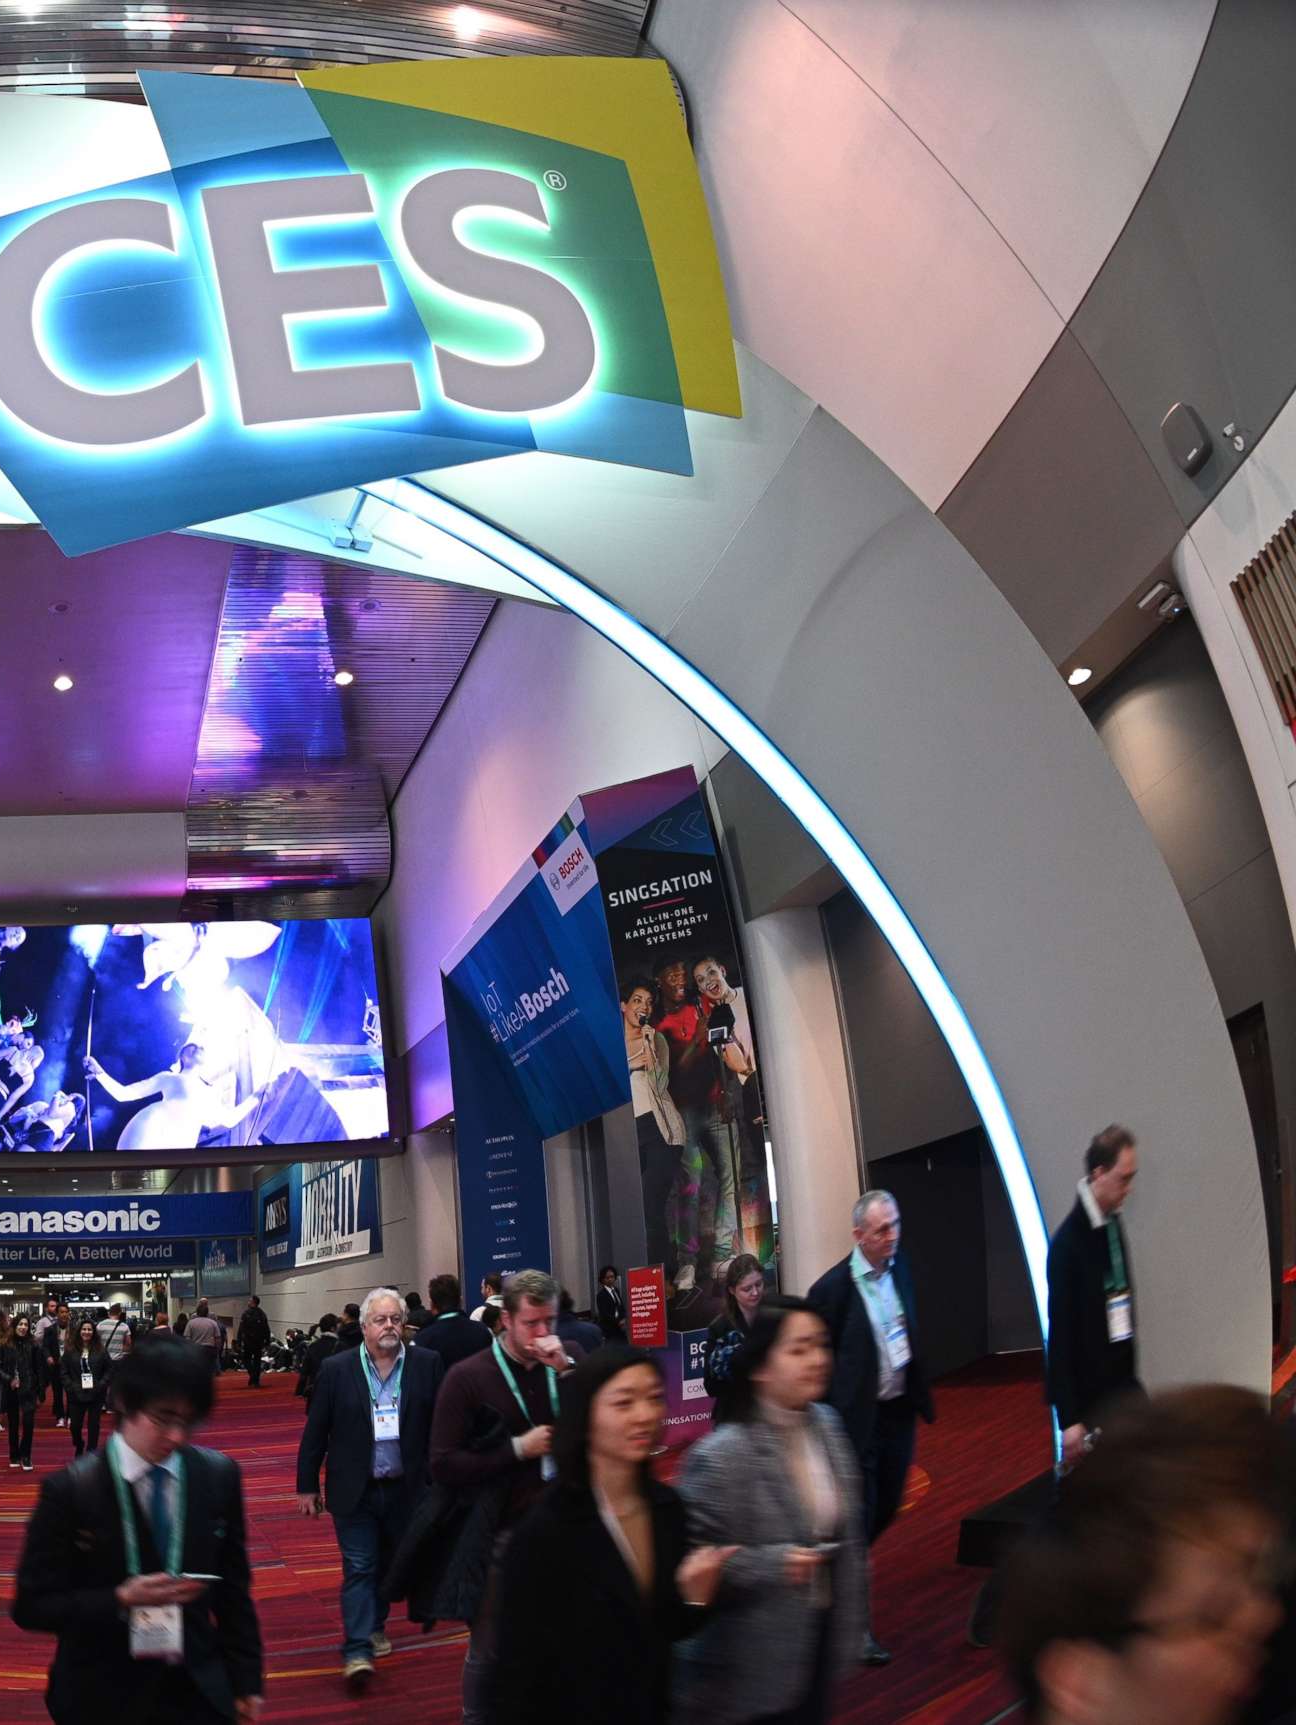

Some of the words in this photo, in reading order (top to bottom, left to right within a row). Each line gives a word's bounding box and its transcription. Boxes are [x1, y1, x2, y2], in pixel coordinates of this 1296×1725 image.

[558, 847, 585, 880] BOSCH
[608, 869, 713, 908] SINGSATION
[624, 921, 673, 940] KARAOKE
[676, 913, 709, 929] PARTY
[635, 905, 695, 927] ALL-IN-ONE
[645, 927, 693, 946] SYSTEMS
[300, 1158, 363, 1250] MOBILITY
[28, 1246, 60, 1263] Life,
[64, 1246, 76, 1260] A
[79, 1246, 125, 1260] Better
[128, 1243, 173, 1259] World
